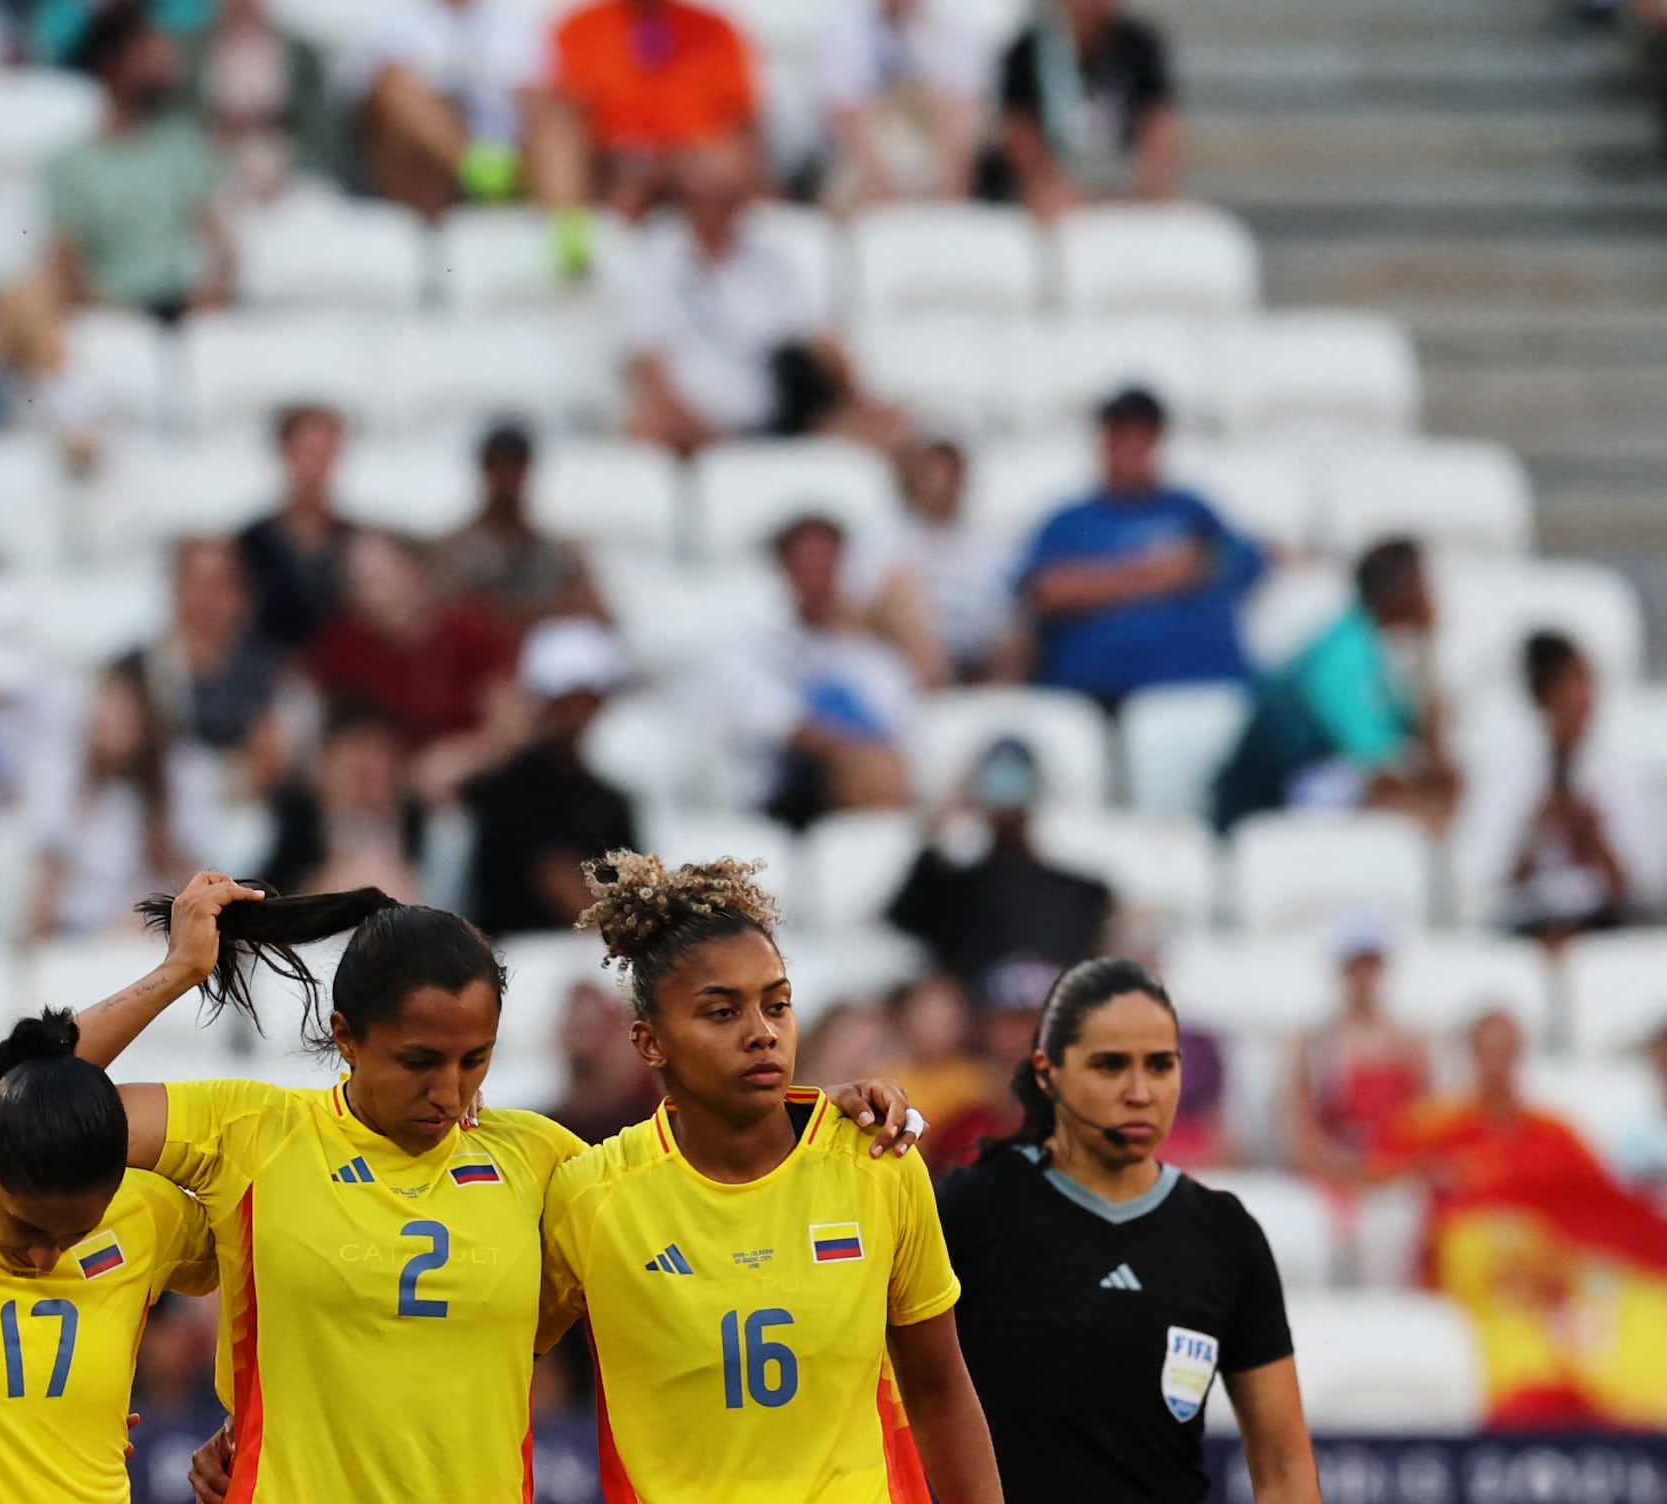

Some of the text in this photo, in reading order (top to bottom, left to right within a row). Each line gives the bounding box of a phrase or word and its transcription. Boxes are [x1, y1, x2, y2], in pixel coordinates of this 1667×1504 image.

[400, 1220, 448, 1317] 2
[2, 1299, 78, 1398] 17
[721, 1308, 798, 1408] 16
[1175, 1335, 1212, 1362] FIFA
